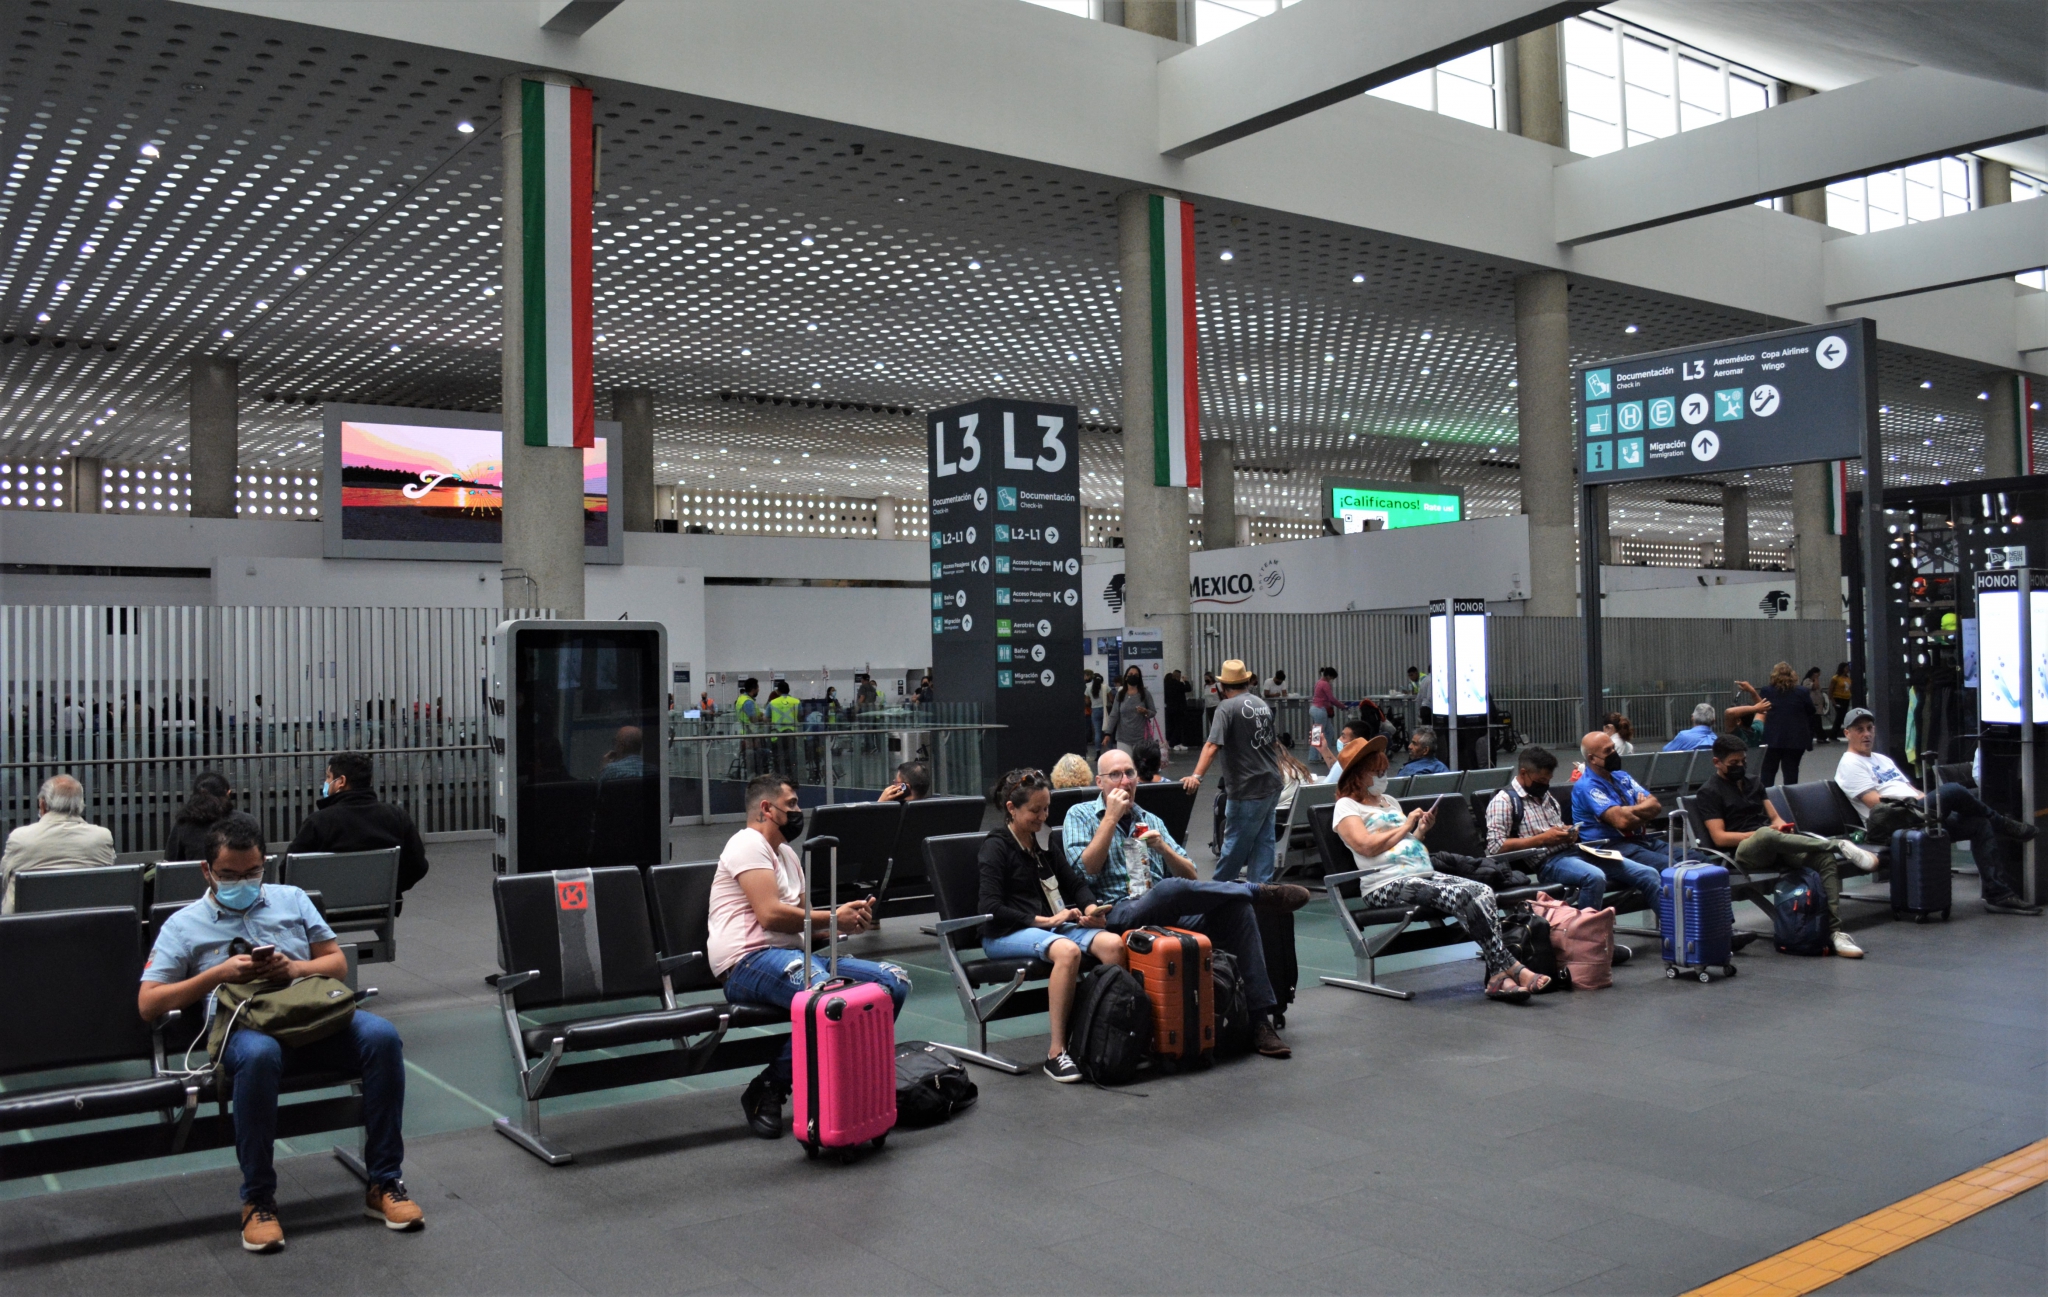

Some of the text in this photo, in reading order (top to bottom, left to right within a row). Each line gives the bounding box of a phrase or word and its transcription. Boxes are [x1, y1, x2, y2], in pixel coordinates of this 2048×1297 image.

[1761, 347, 1809, 359] Copa Airlines
[1713, 353, 1755, 366] Aeroméxico
[1616, 360, 1705, 381] Documentación L3
[1713, 368, 1744, 377] Aeromar
[1761, 362, 1785, 371] Wingo
[1624, 404, 1668, 425] H E
[936, 412, 981, 478] L3
[1003, 411, 1067, 473] L3
[1649, 440, 1687, 452] Migración
[1649, 451, 1684, 459] Immigration
[932, 493, 972, 507] Documentación
[1020, 491, 1075, 502] Documentación
[1340, 495, 1420, 510] ¡Califícanos!
[1423, 503, 1441, 511] Rate
[932, 507, 949, 515] Check-in
[942, 531, 964, 545] L2-L1
[1011, 528, 1040, 540] L2-L1
[971, 560, 978, 572] K
[1053, 560, 1063, 572] M
[1978, 575, 2017, 587] HONOR
[1053, 591, 1061, 603] K
[1430, 602, 1445, 613] HONOR
[1454, 602, 1484, 612] HONOR
[1128, 646, 1138, 655] L3
[1014, 672, 1039, 680] Migración
